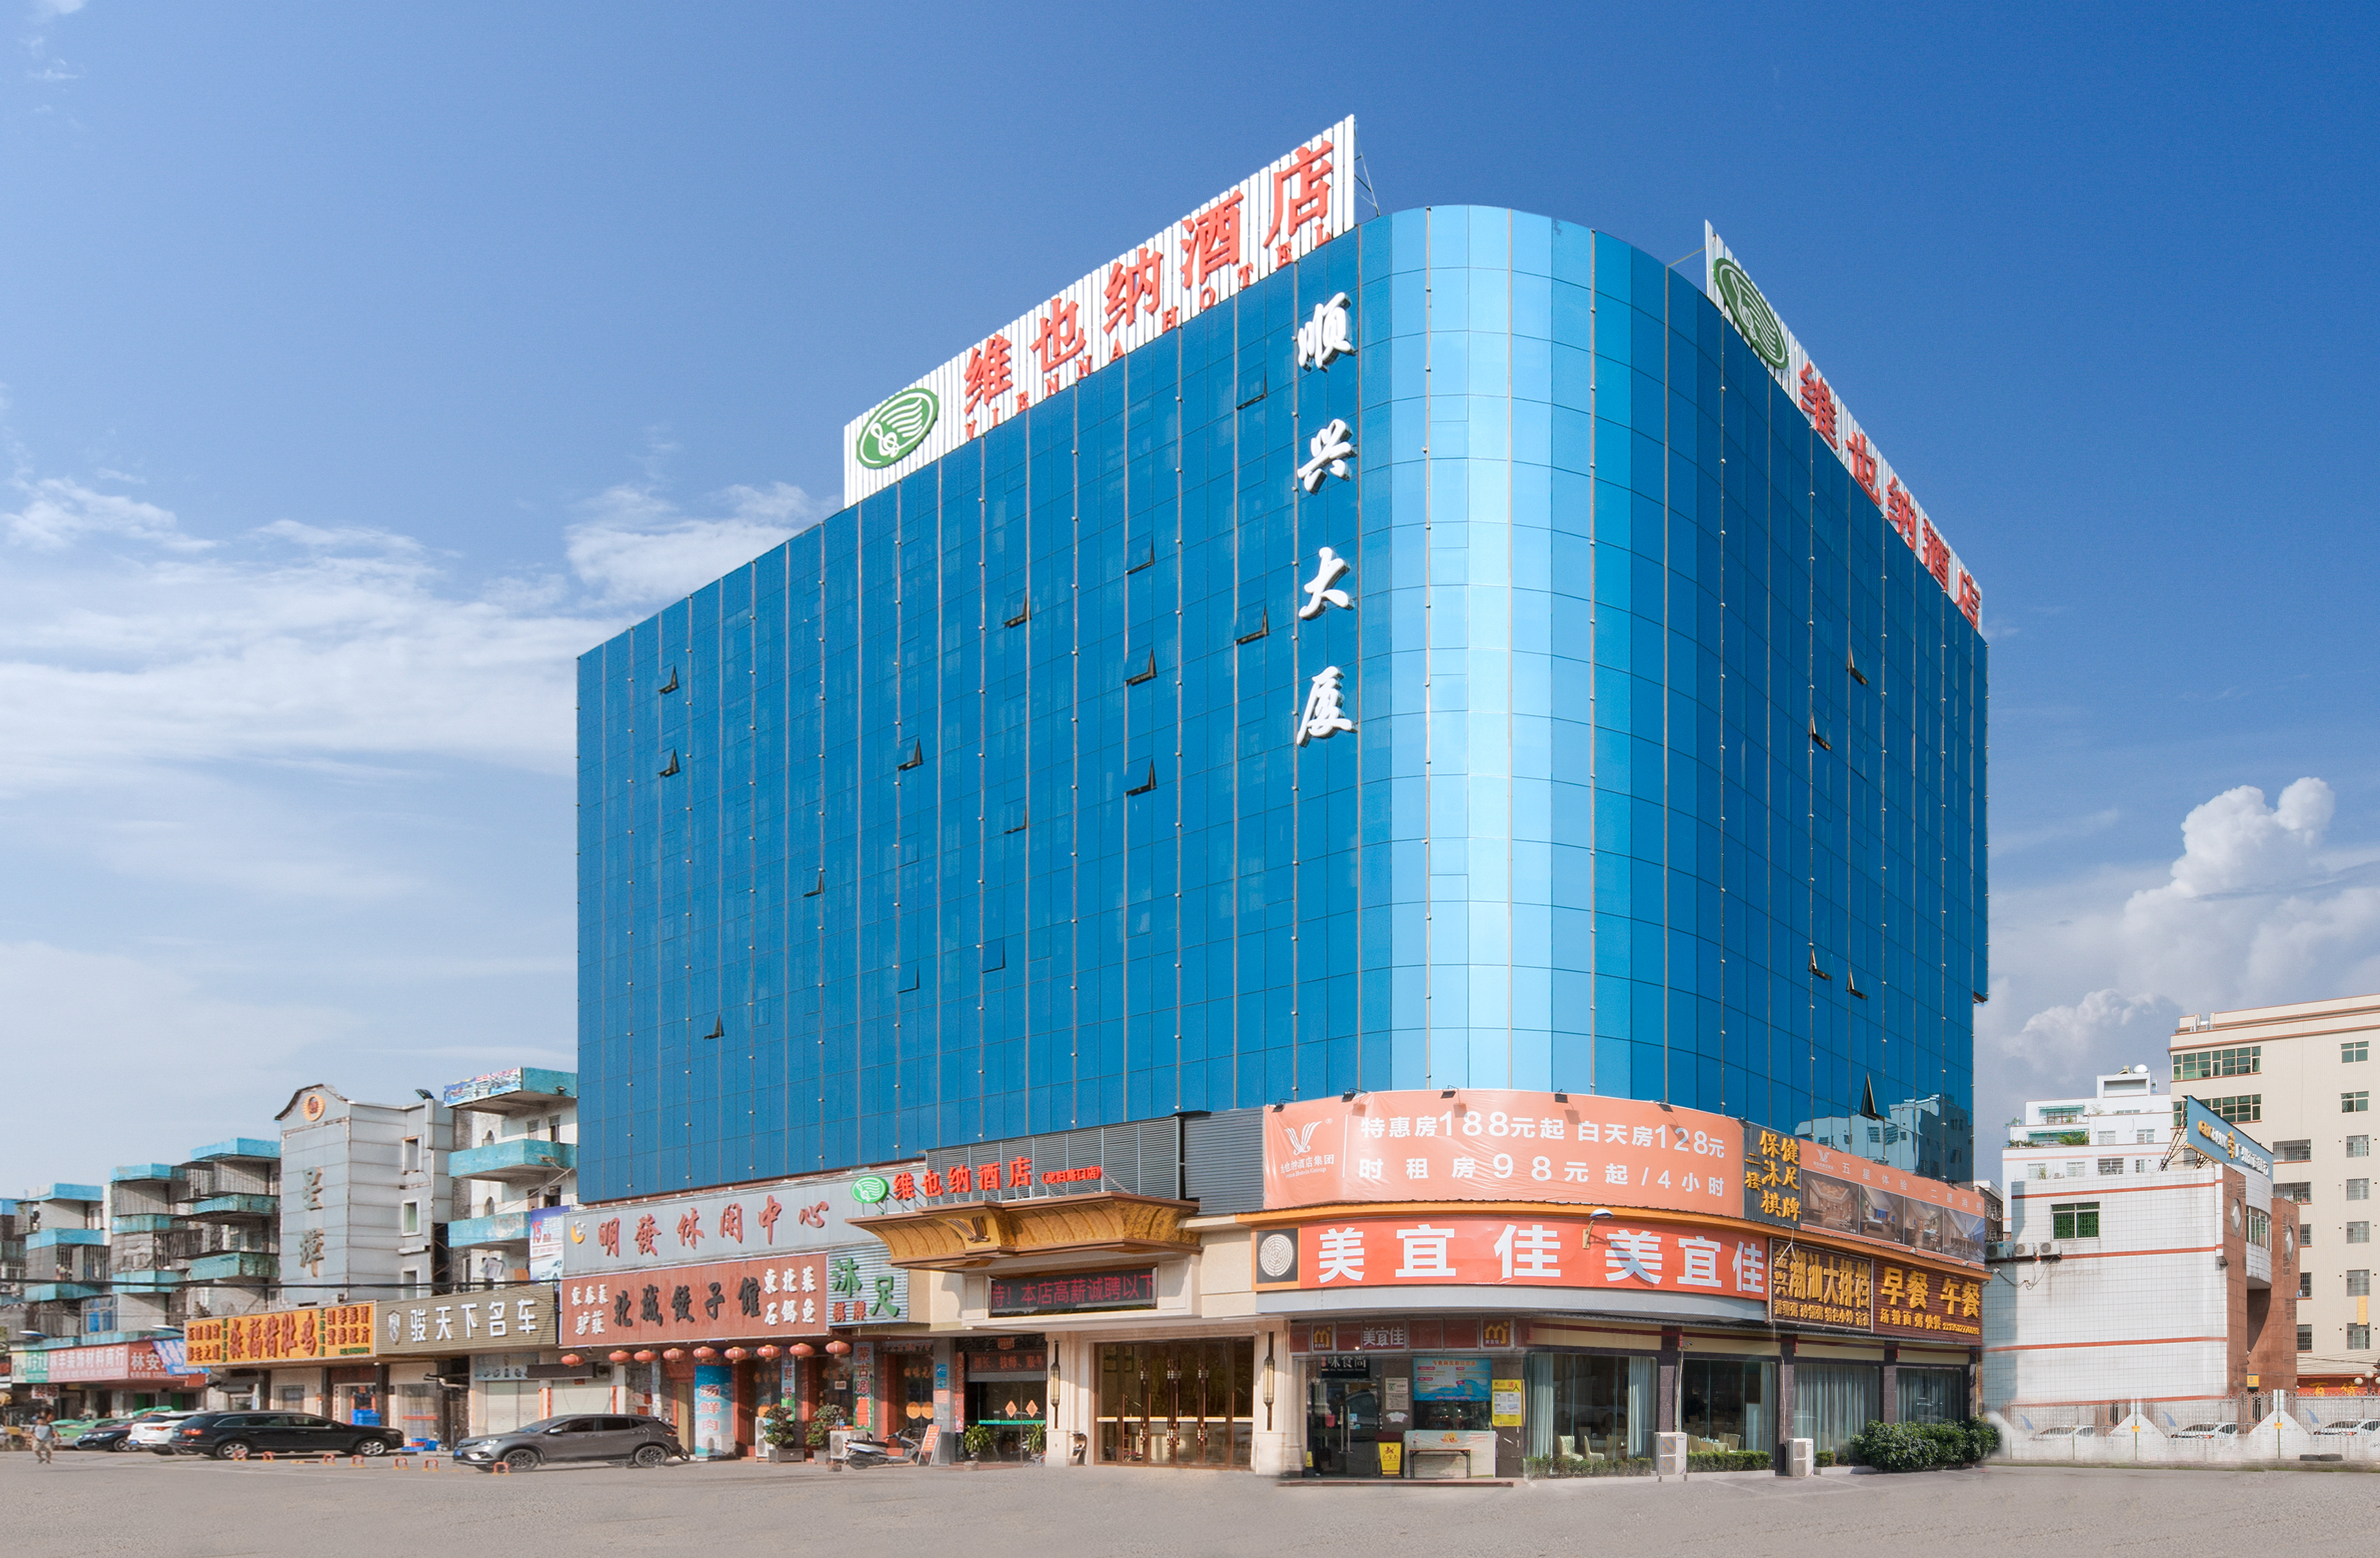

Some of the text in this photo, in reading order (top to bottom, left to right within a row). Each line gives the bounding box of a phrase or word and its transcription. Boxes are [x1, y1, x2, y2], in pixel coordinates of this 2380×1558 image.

[964, 140, 1334, 415] 维也纳酒店
[966, 224, 1331, 441] VIENNA HOTEL
[1799, 361, 1981, 629] 维也纳酒店
[1361, 1110, 1725, 1158] 特惠房188元起 白天房128元
[1759, 1130, 1801, 1165] 保健
[893, 1157, 1033, 1200] 维也纳酒店
[1745, 1153, 1762, 1191] 二楼
[1761, 1161, 1801, 1190] 沐足
[1760, 1190, 1802, 1222] 棋牌
[1318, 1224, 1764, 1294] 美宜佳 美宜佳
[1881, 1266, 1980, 1318] 早餐 午餐
[410, 1298, 537, 1343] 骏天下名车
[1362, 1327, 1405, 1346] 美宜佳
